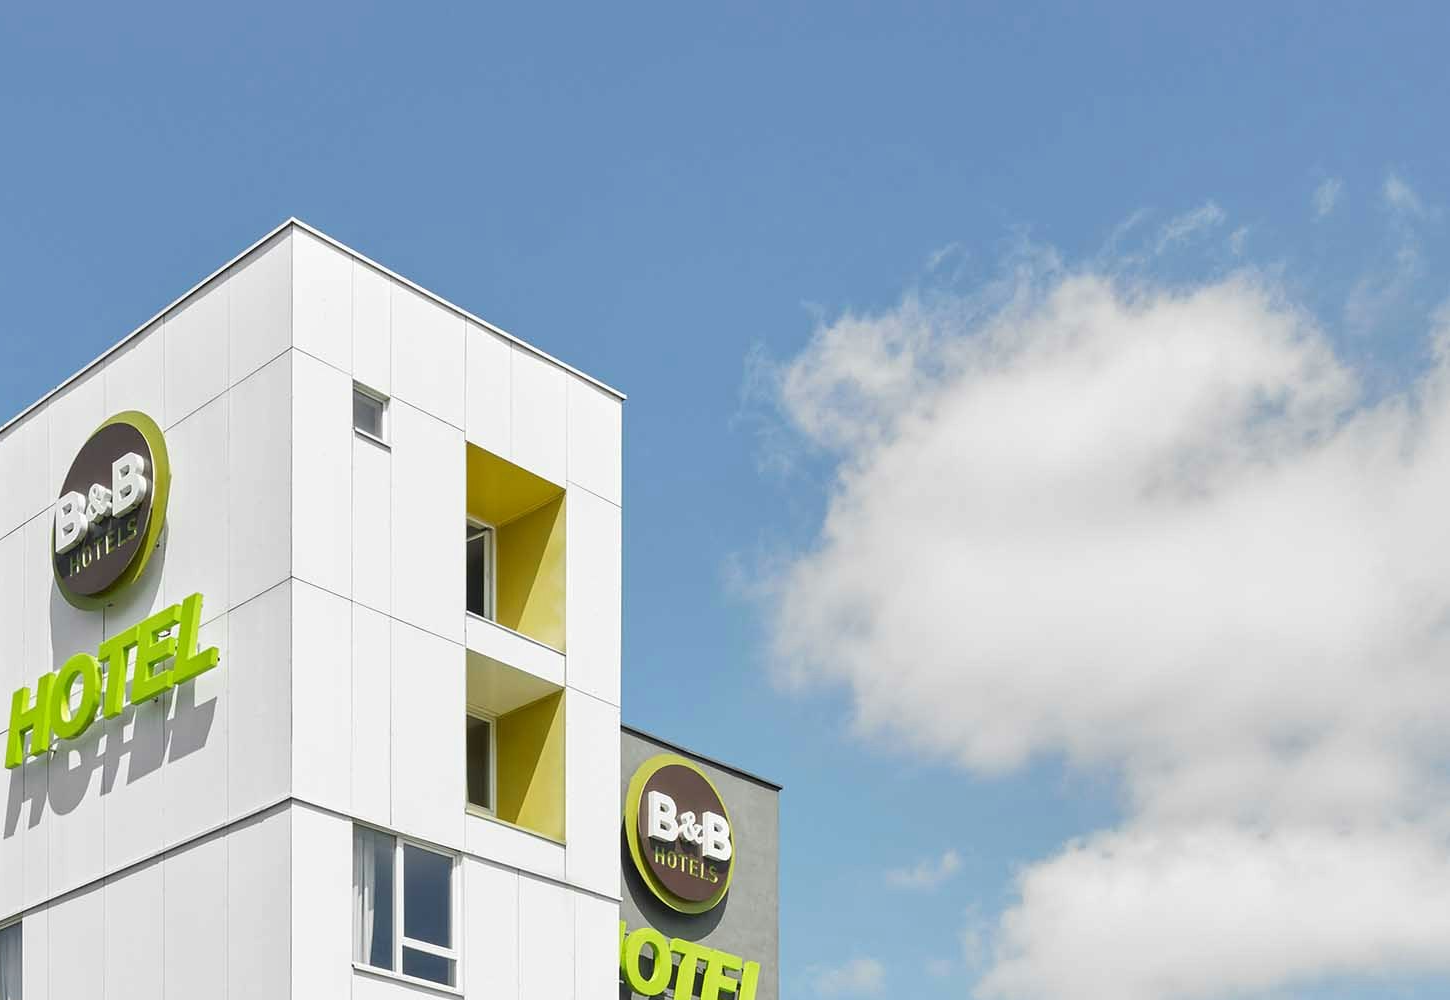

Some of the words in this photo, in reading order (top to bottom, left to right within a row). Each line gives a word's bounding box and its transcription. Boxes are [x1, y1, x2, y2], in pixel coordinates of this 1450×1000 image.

[55, 451, 147, 555] B&B
[69, 518, 138, 577] HOTELS
[5, 592, 219, 770] HOTEL
[648, 790, 732, 862] B&B
[653, 845, 719, 884] HOTELS
